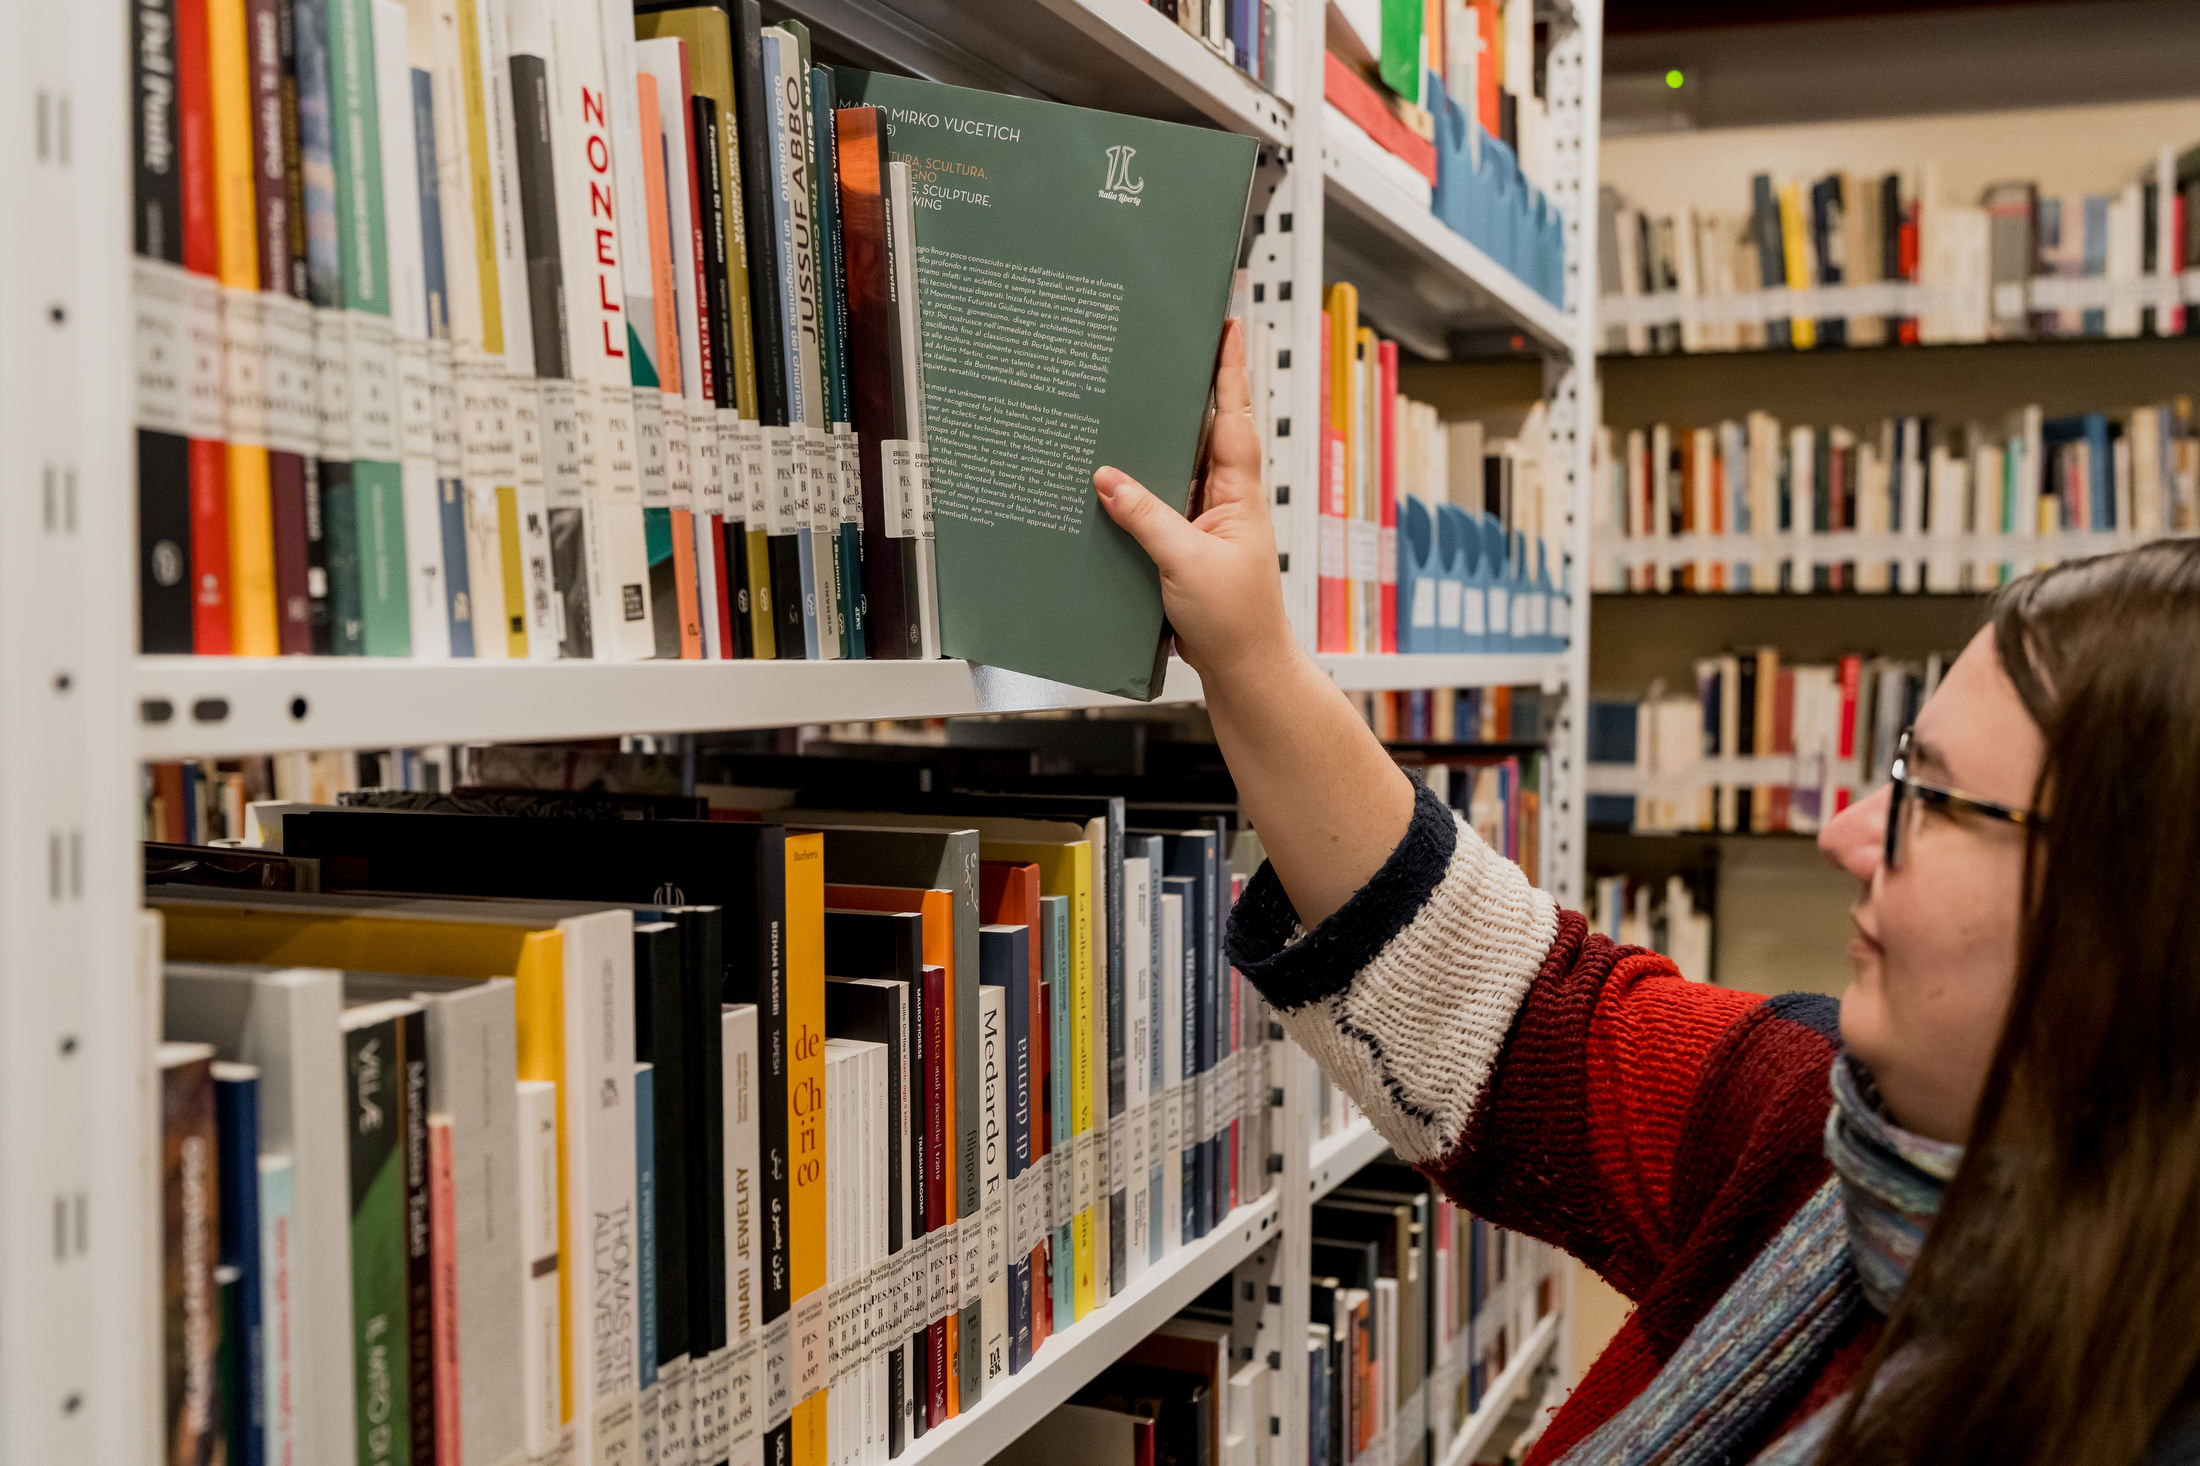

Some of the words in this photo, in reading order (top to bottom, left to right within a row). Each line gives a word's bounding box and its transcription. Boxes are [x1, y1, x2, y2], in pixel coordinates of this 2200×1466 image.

[775, 75, 784, 127] OSCAR
[803, 58, 811, 106] Arte
[786, 77, 806, 194] ABBO
[806, 110, 815, 164] Sella
[829, 108, 837, 169] Medardo
[891, 107, 940, 129] MIRKO
[944, 115, 1021, 143] VUCETICH
[778, 132, 789, 202] SORGATO
[925, 157, 989, 180] SCULTURA,
[923, 183, 992, 208] SCULPTURE,
[1098, 189, 1118, 201] Italia
[1118, 192, 1142, 207] Liberty
[582, 86, 624, 358] NONELL
[715, 211, 723, 263] Stefano
[784, 220, 791, 238] un
[784, 241, 796, 326] protagonista
[794, 200, 816, 344] JUSSUF
[931, 247, 951, 258] finora
[950, 252, 967, 261] poco
[968, 256, 1004, 267] conosciuto
[1066, 273, 1089, 283] incerta
[1096, 279, 1124, 291] sfumata,
[931, 259, 961, 269] profondo
[969, 267, 1001, 277] minuzioso
[1011, 273, 1035, 283] Andrea
[1037, 278, 1063, 290] Speziali,
[1076, 287, 1096, 296] artista
[813, 224, 827, 369] Contemporary
[791, 329, 799, 352] del
[792, 355, 803, 423] chiarismo
[931, 384, 949, 393] most
[957, 390, 986, 400] unknown
[988, 396, 1006, 405] artist,
[1020, 402, 1041, 412] thanks
[1063, 413, 1099, 424] meticulous
[944, 398, 980, 409] recognized
[1006, 410, 1029, 420] talents,
[1045, 418, 1057, 426] just
[1081, 426, 1097, 435] artist
[825, 581, 833, 636] WIENAND
[793, 850, 818, 862] Barbero
[772, 968, 780, 1017] BASSIRI
[795, 1024, 820, 1061] de
[934, 1007, 942, 1064] estetica.
[1080, 1015, 1088, 1091] Cavallino
[793, 1077, 822, 1117] Ch
[984, 1008, 1000, 1166] Medardo
[1016, 1036, 1029, 1125] donna
[965, 1130, 978, 1182] filippo
[1016, 1134, 1028, 1159] di
[797, 1159, 820, 1187] co
[966, 1186, 977, 1208] de
[736, 1167, 750, 1260] JEWELRY
[611, 1199, 632, 1335] THOMAS
[738, 1268, 751, 1335] UNARI
